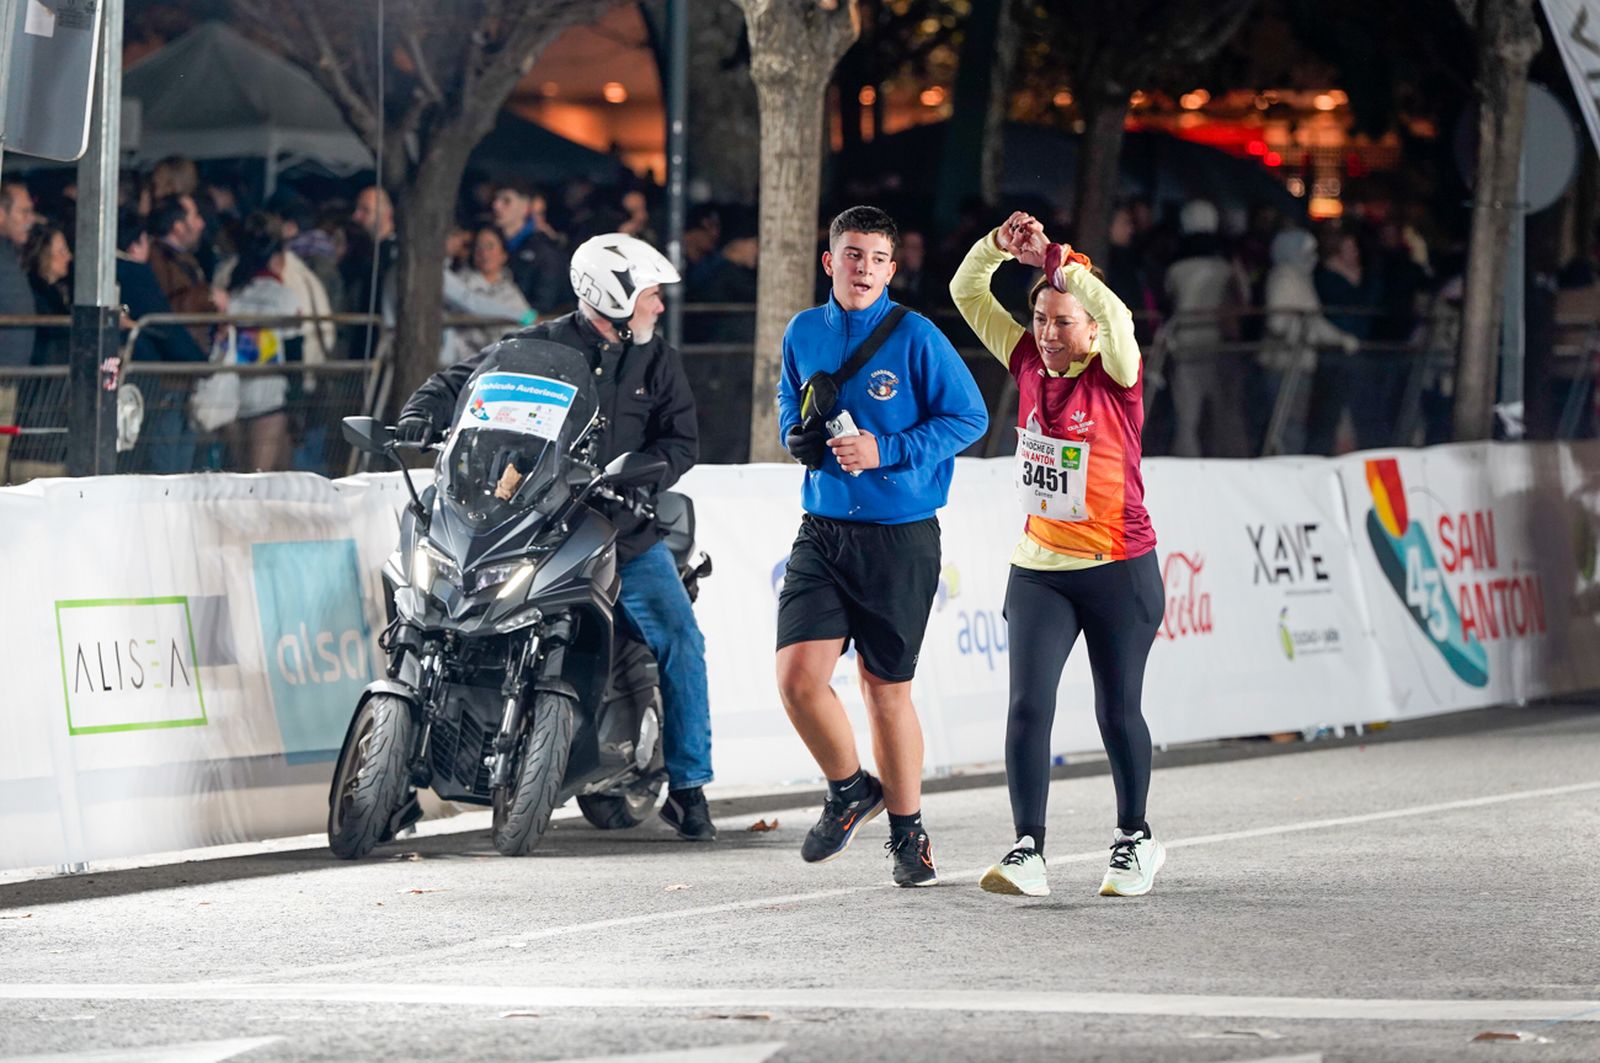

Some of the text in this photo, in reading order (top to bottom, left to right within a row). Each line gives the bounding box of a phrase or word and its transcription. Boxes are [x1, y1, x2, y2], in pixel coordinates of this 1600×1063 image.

[1023, 461, 1068, 494] 3451
[1046, 446, 1055, 455] DE
[1437, 509, 1498, 575] SAN
[1405, 546, 1450, 642] 43
[1459, 560, 1547, 644] ANTÓN
[75, 638, 190, 693] ALISEA
[277, 622, 368, 684] alsa
